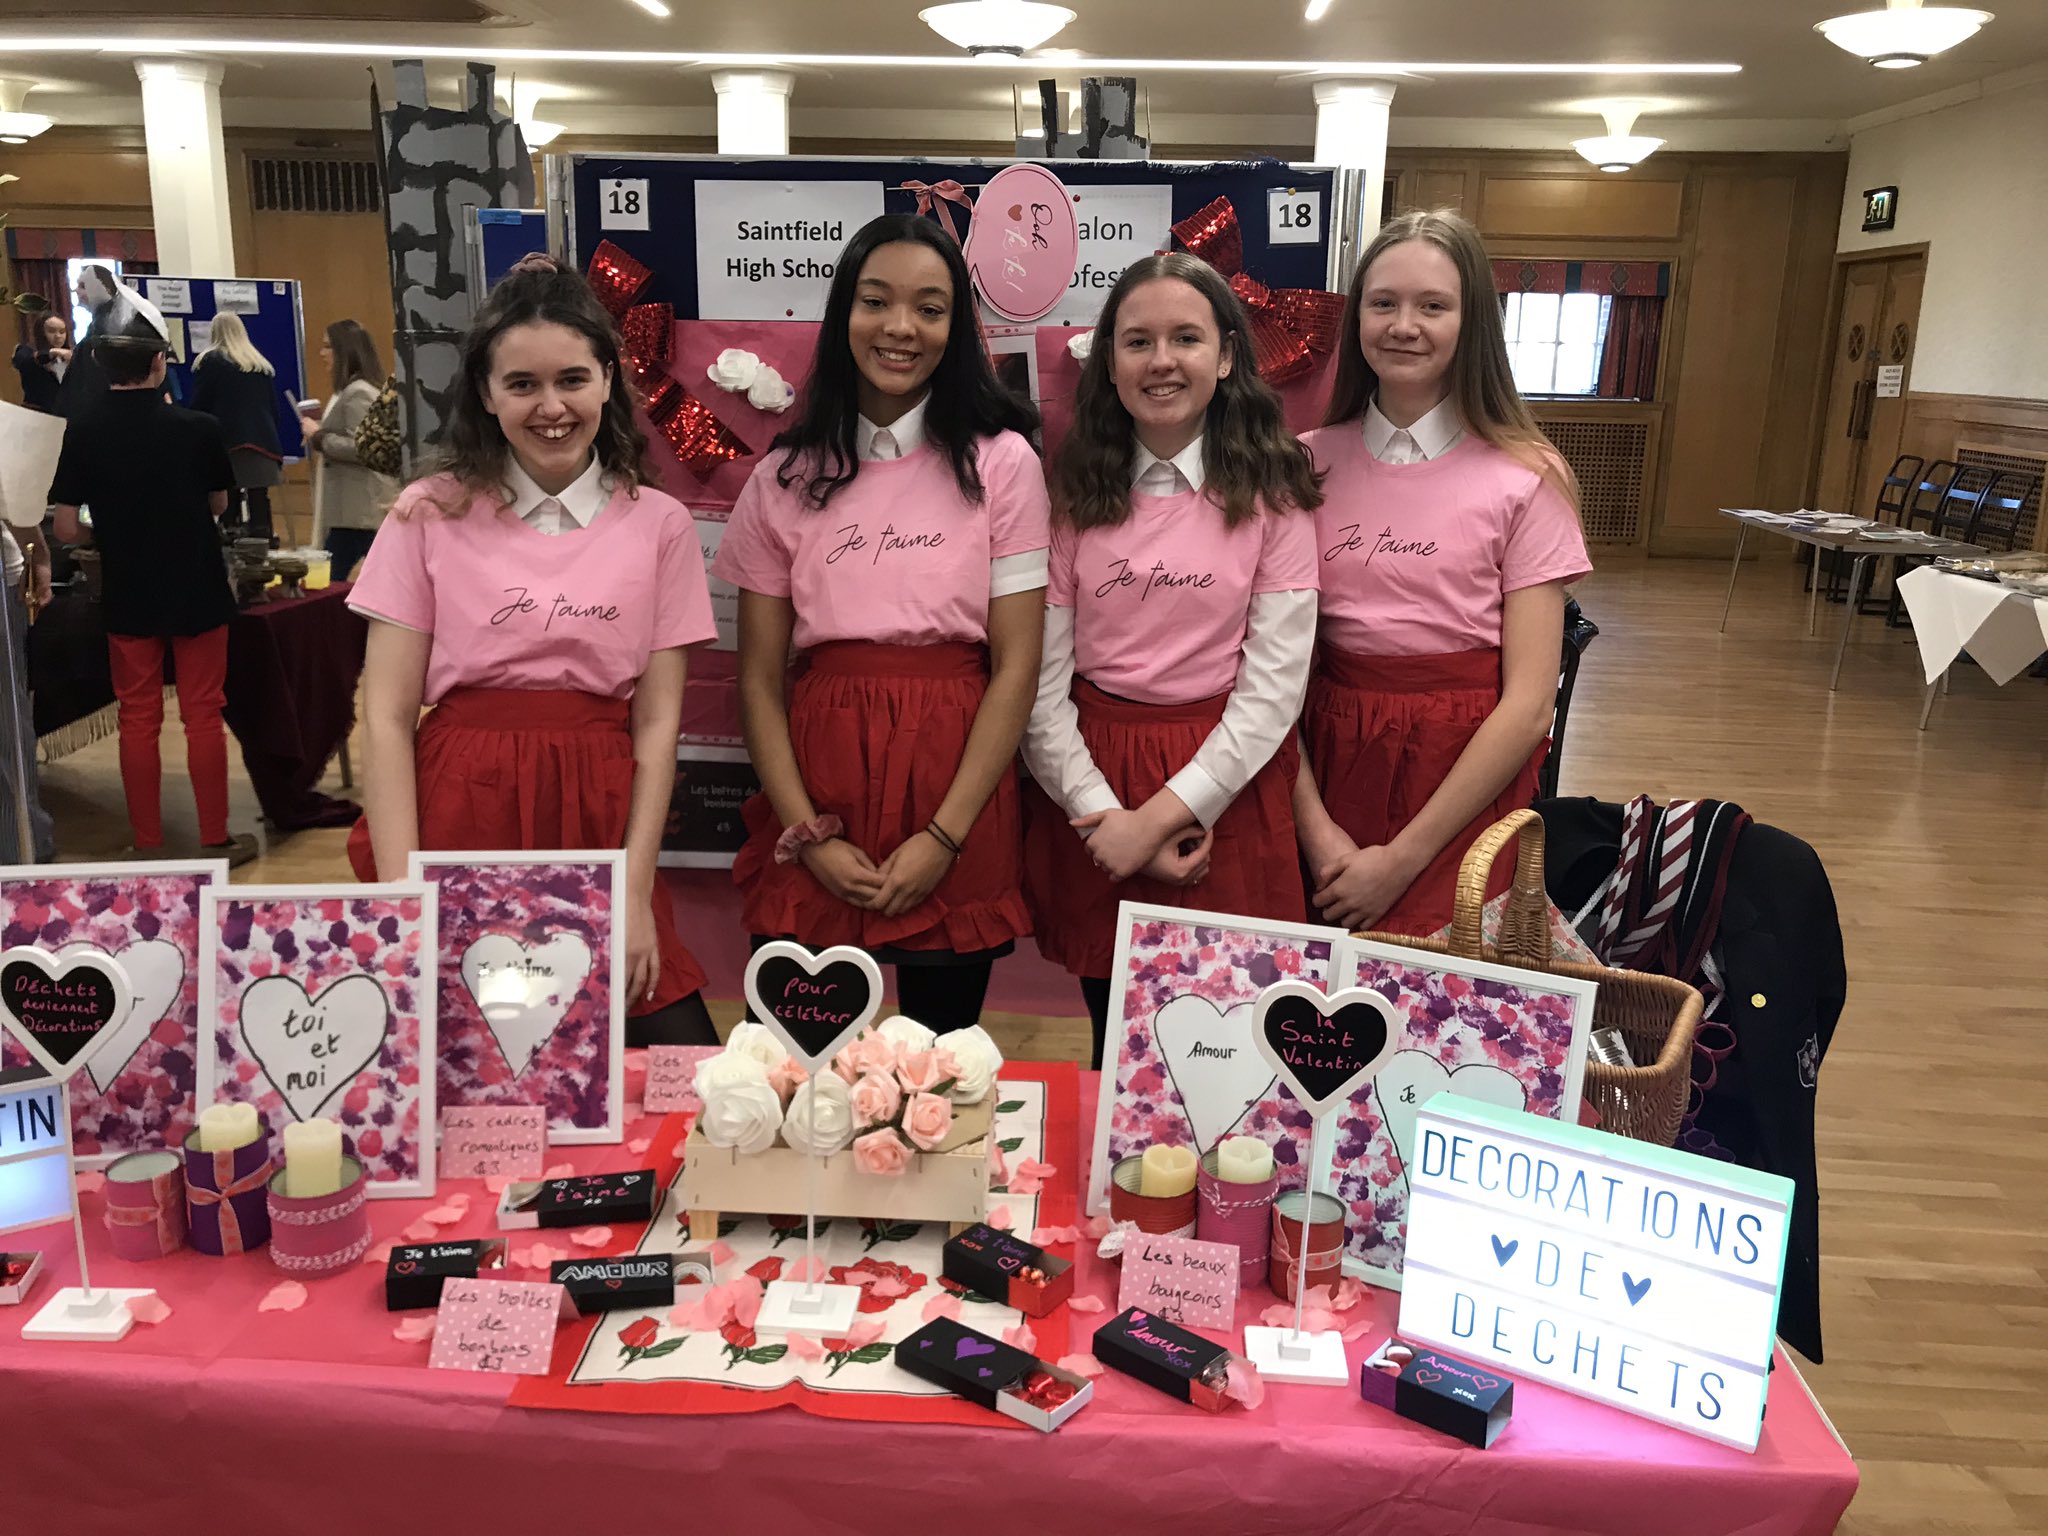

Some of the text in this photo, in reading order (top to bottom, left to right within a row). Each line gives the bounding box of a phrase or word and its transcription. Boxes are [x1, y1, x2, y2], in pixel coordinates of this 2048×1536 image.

[607, 190, 641, 215] 18
[1278, 202, 1313, 228] 18
[736, 220, 843, 242] Saintfield
[1078, 215, 1133, 241] alon
[726, 257, 837, 282] High Scho
[826, 523, 946, 566] Je t'aime
[1323, 523, 1439, 567] Je t'aime
[1095, 558, 1217, 602] Je t'aime
[490, 587, 621, 632] Je t'aime
[282, 1006, 328, 1039] toi
[1280, 1019, 1355, 1048] Saint
[310, 1033, 342, 1058] et
[1186, 1041, 1238, 1060] Amour
[1282, 1046, 1363, 1070] Valentin
[285, 1065, 326, 1091] moi
[1400, 1084, 1416, 1105] Je
[444, 1112, 539, 1129] Les cadres
[1421, 1129, 1763, 1265] DECORATIONS
[404, 1248, 424, 1260] Je
[1142, 1245, 1227, 1276] Les beaux
[556, 1261, 670, 1282] AMOUR
[1534, 1240, 1605, 1301] DE
[446, 1284, 479, 1303] Les
[478, 1313, 508, 1331] de
[1126, 1326, 1197, 1356] Amour
[1419, 1355, 1472, 1378] Amour
[1451, 1292, 1725, 1421] DECHETS
